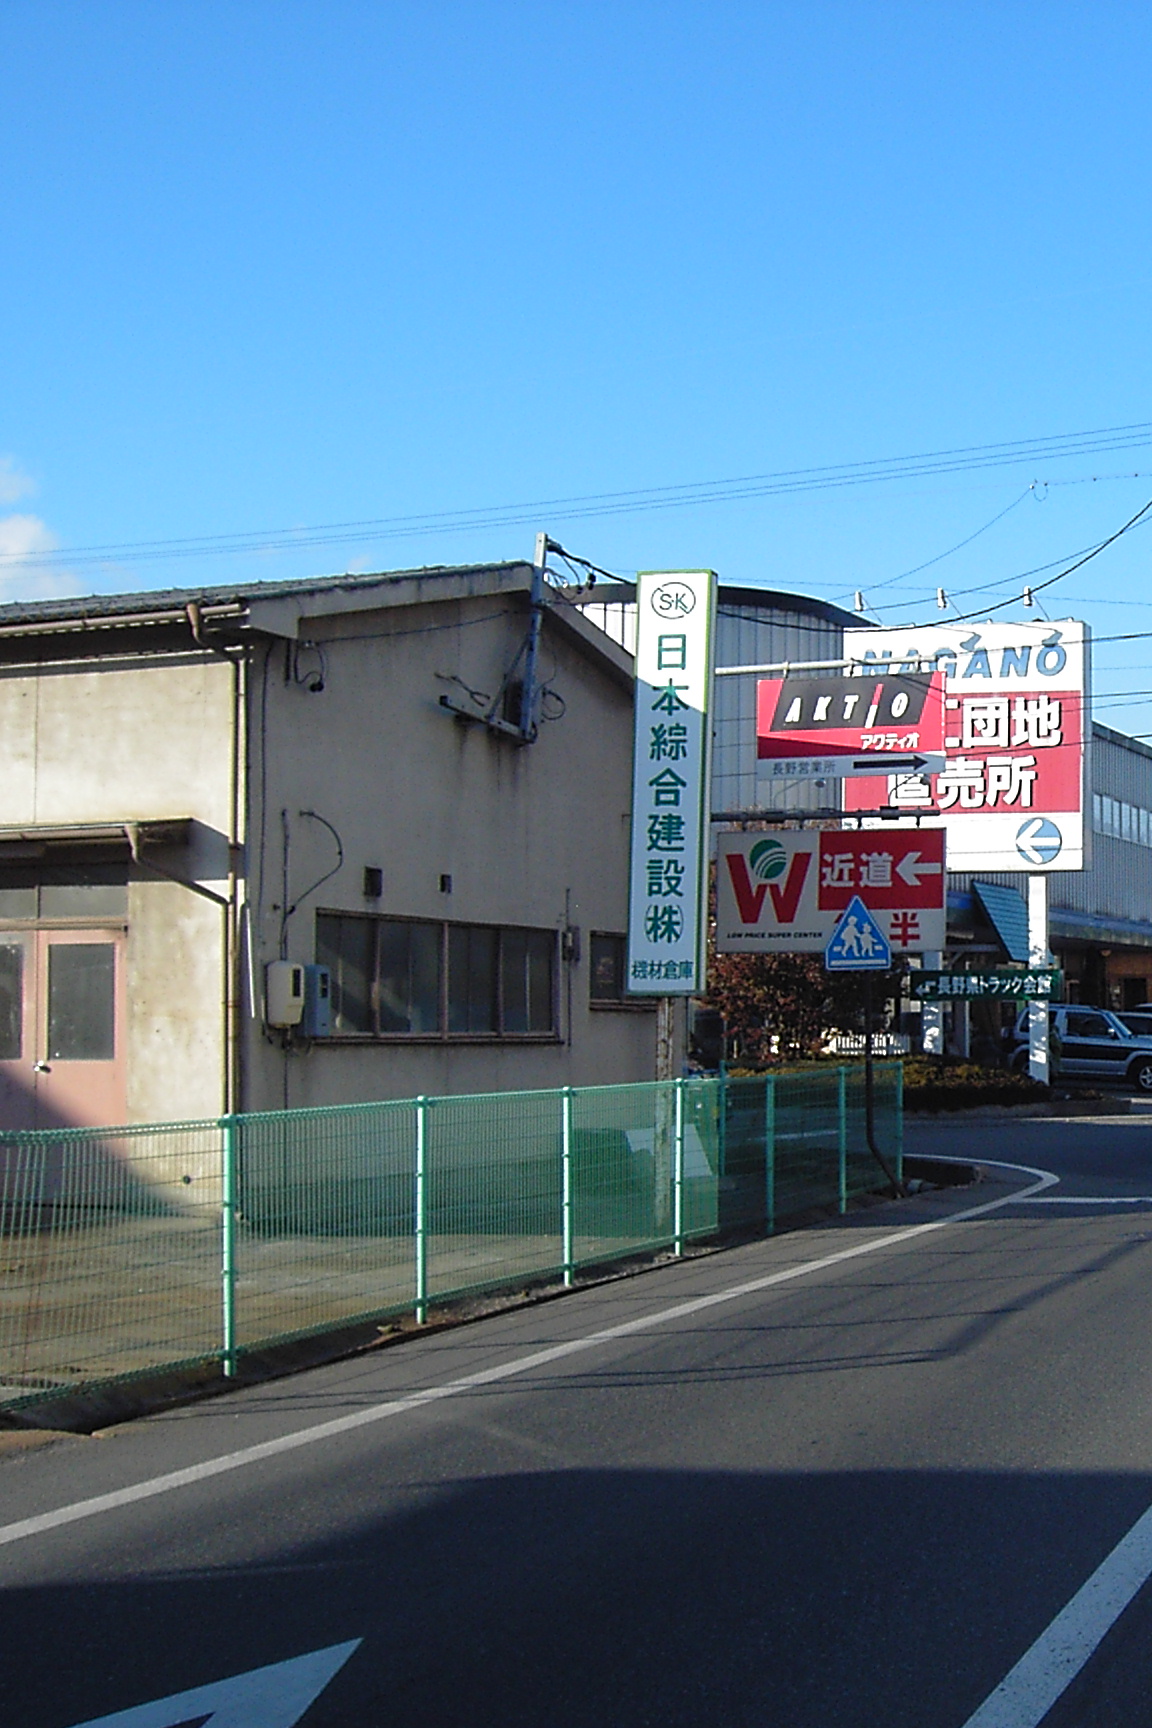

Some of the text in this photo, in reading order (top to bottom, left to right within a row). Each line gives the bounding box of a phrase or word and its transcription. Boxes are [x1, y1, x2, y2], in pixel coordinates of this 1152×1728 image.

[862, 644, 1067, 679] NAGANO
[785, 683, 910, 729] AKTIO
[860, 732, 920, 750] アクティオ
[772, 759, 837, 776] 長野営業所
[821, 852, 893, 887] 近道
[727, 931, 823, 939] LOW PRICE SUPER CENTER
[631, 959, 694, 980] 機材倉庫
[937, 974, 1053, 995] 長野県トラック会館
